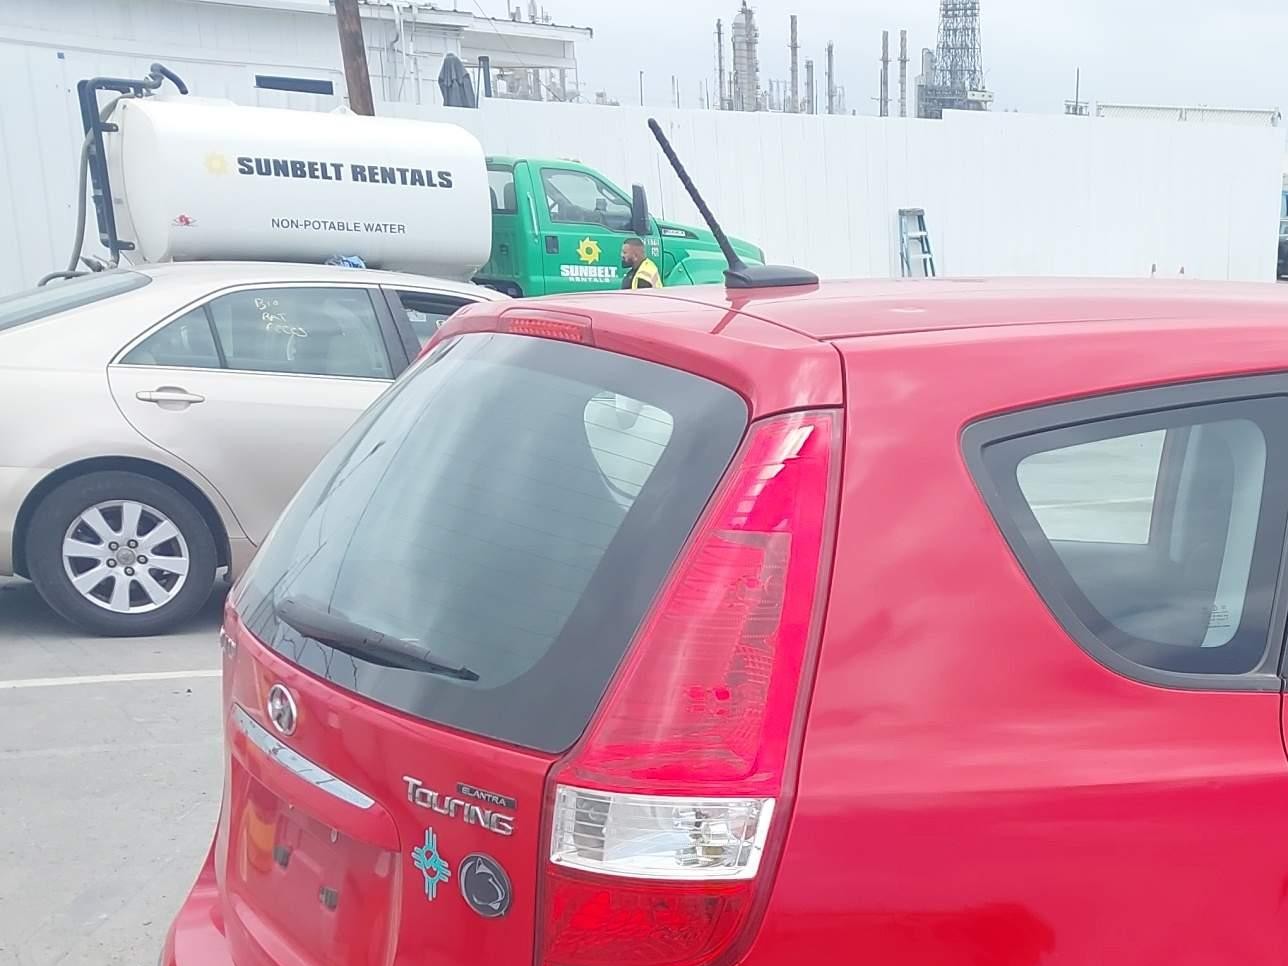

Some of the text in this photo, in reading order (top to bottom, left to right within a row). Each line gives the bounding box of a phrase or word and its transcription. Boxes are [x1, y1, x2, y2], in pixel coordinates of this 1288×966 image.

[237, 156, 453, 189] SUNBELT RENTALS
[270, 217, 406, 235] NON-POTABLE WATER
[461, 785, 507, 807] ELANTRA
